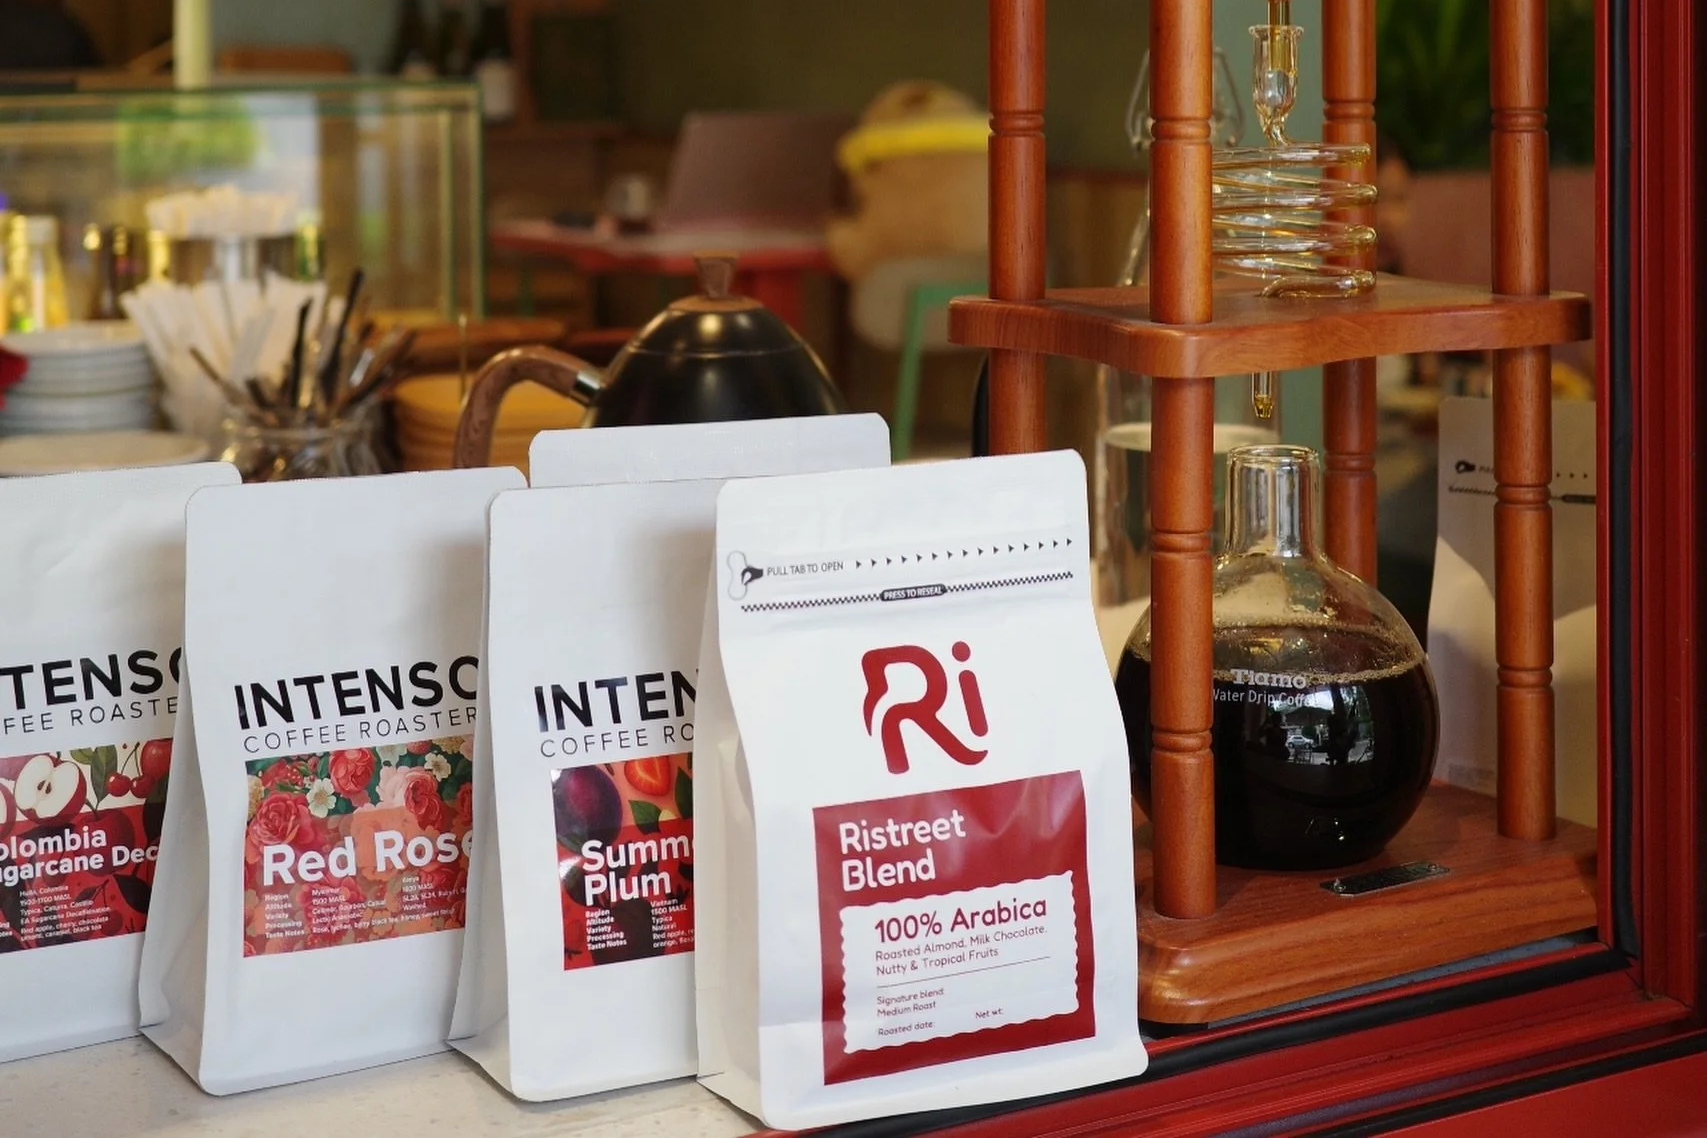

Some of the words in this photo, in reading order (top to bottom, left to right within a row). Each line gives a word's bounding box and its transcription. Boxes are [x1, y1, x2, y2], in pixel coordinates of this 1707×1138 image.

[767, 566, 788, 576] PULL
[790, 565, 806, 574] TAB
[807, 563, 818, 573] TO
[821, 561, 844, 572] OPEN
[883, 590, 906, 600] PRESS
[907, 588, 916, 597] TO
[917, 586, 943, 596] RESEAL
[0, 647, 182, 710] TENS
[1230, 669, 1307, 689] Tiamo
[861, 641, 989, 774] Ri
[1248, 690, 1275, 705] Drip
[243, 724, 347, 754] COFFEE
[540, 728, 649, 758] COFFEE
[839, 809, 966, 854] Ristreet
[263, 836, 357, 887] Red
[581, 834, 695, 872] Summ
[0, 853, 105, 887] garcane
[841, 848, 936, 892] Blend
[584, 871, 672, 907] Plum
[585, 909, 610, 918] Region
[586, 916, 614, 927] Altitude
[874, 910, 943, 943] 100%
[950, 897, 1047, 933] Arabica
[586, 924, 612, 935] Variety
[586, 931, 624, 942] Processing
[587, 942, 606, 951] Taste
[606, 939, 627, 948] Notes
[875, 945, 921, 962] Roasted
[970, 934, 990, 947] Milk
[876, 963, 907, 976] Nutty
[910, 960, 919, 971] &
[922, 951, 966, 969] Tropical
[969, 947, 999, 961] Fruits
[877, 994, 919, 1007] Signature
[877, 1007, 911, 1017] Medium
[912, 1001, 937, 1012] Roast
[975, 1010, 989, 1019] Net
[878, 1023, 912, 1036] Roasted
